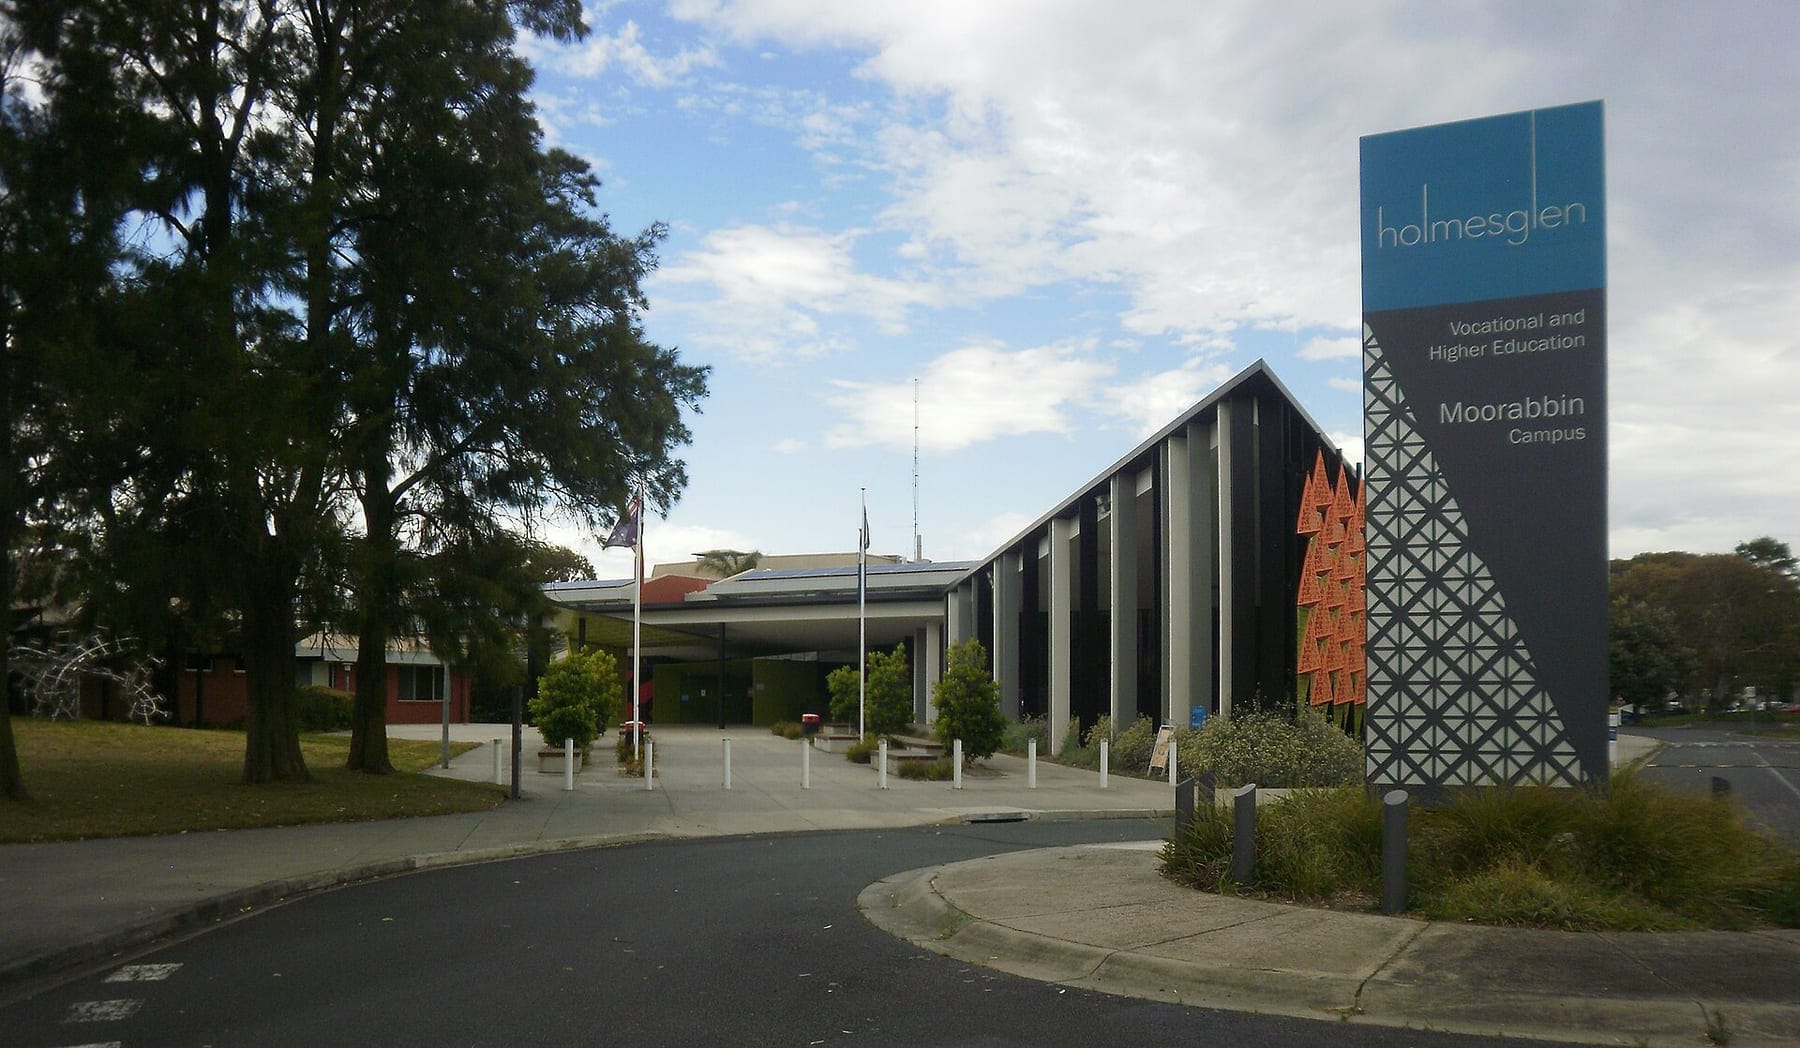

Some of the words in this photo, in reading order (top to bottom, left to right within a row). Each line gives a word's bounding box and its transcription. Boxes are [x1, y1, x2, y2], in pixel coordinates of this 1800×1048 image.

[1378, 110, 1587, 248] holmesglen
[1450, 313, 1543, 336] Vocational
[1549, 309, 1585, 326] and
[1430, 344, 1487, 362] Higher
[1493, 334, 1585, 355] Education
[1440, 395, 1585, 424] Moorabbin
[1509, 427, 1587, 445] Campus
